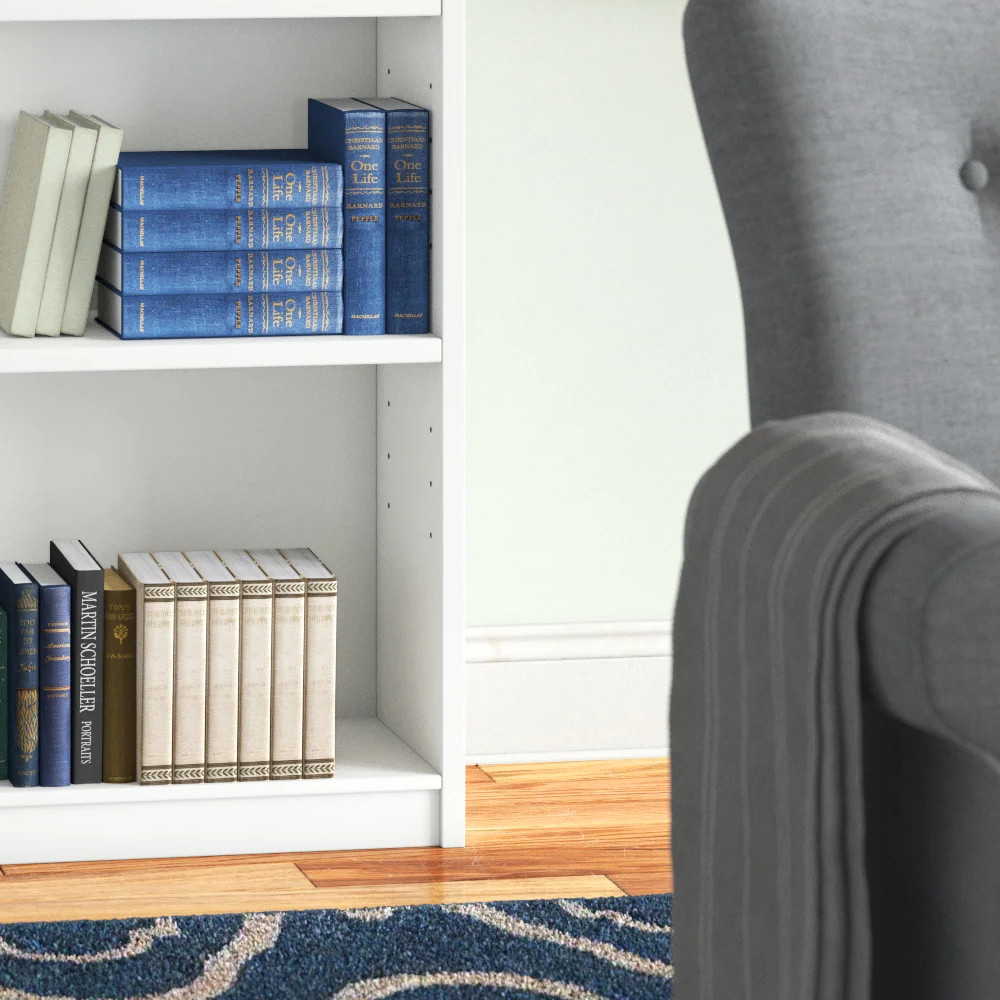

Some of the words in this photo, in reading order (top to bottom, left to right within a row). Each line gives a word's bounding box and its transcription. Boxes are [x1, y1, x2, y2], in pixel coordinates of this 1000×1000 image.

[350, 160, 379, 171] One
[353, 173, 379, 184] Life
[393, 159, 422, 170] One
[396, 172, 422, 183] Life
[272, 175, 283, 201] Life
[285, 172, 296, 201] One
[272, 216, 283, 242] Life
[285, 213, 296, 243] One
[272, 258, 283, 286] Life
[285, 256, 296, 285] One
[272, 301, 283, 328] Life
[285, 298, 296, 328] One
[80, 591, 98, 641] MARTIN
[79, 642, 97, 713] SCHOELLER
[80, 721, 93, 765] PORTRAITS
